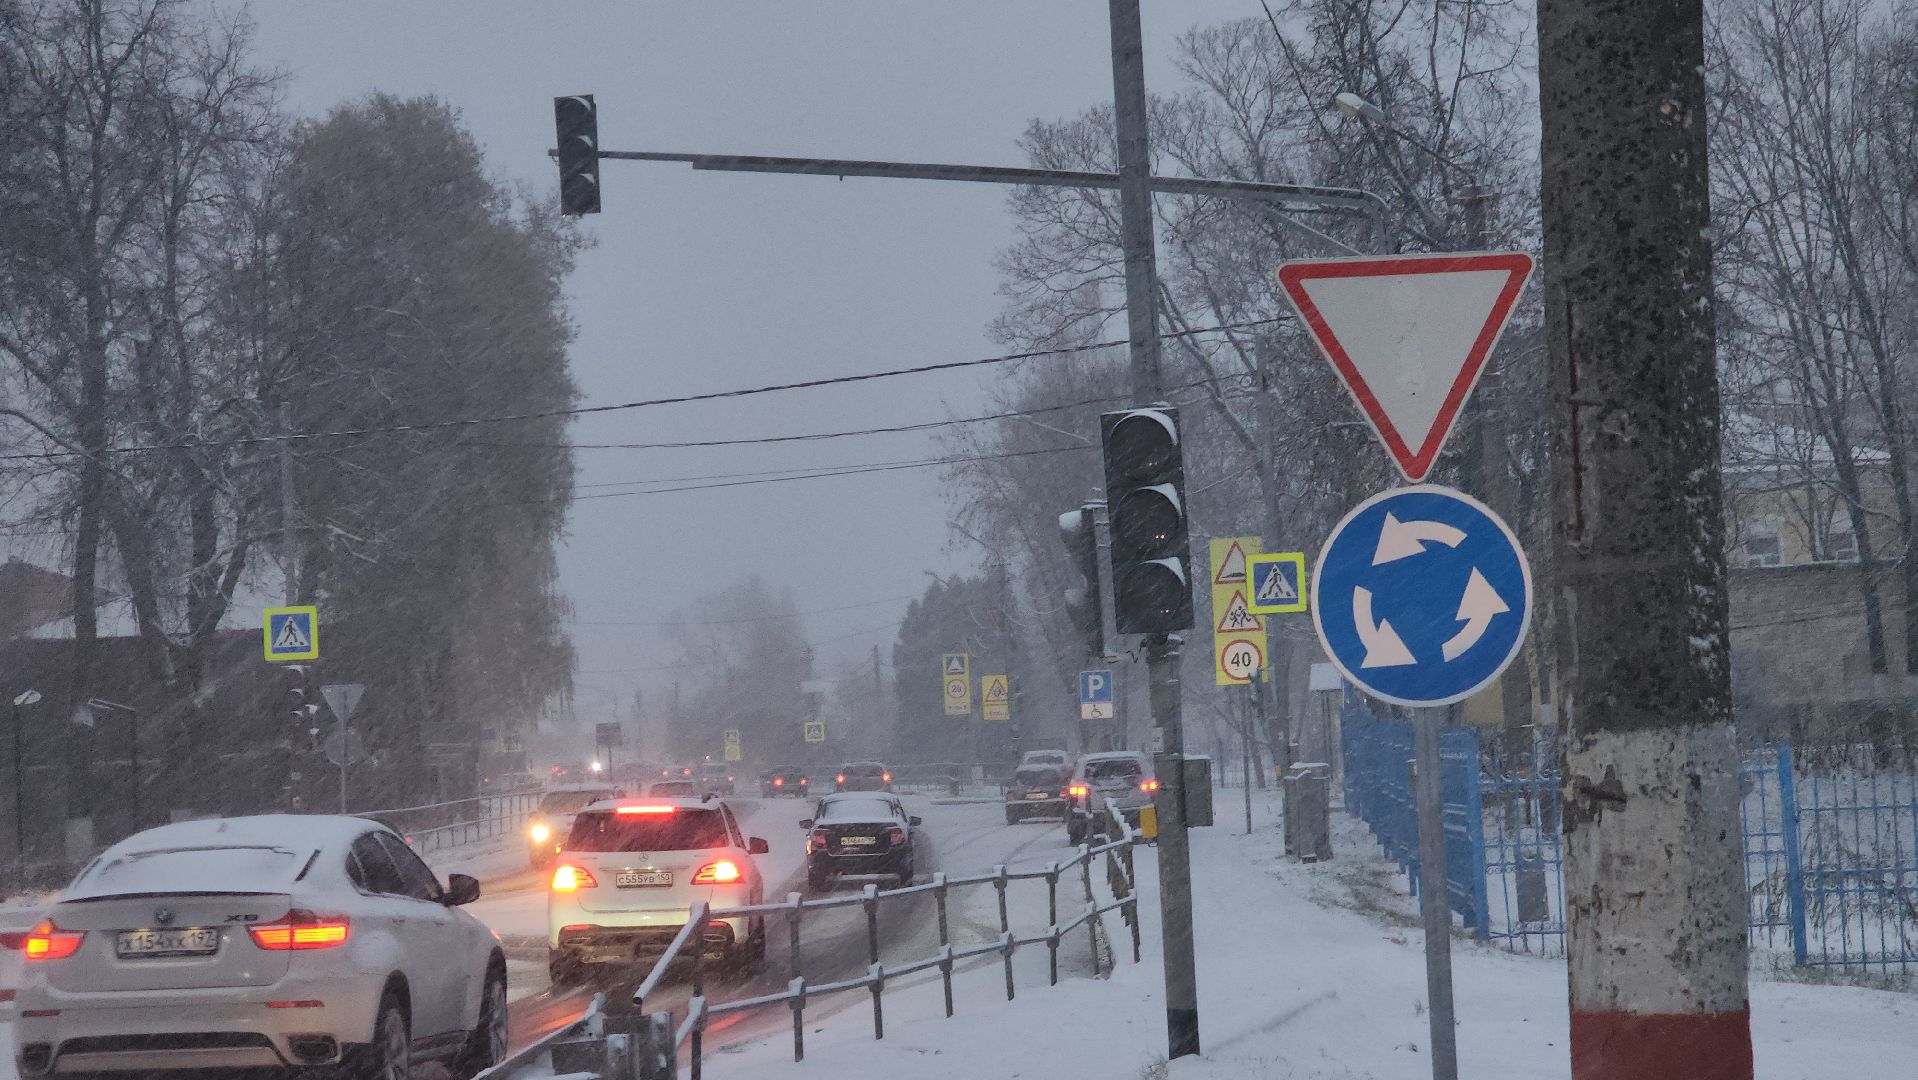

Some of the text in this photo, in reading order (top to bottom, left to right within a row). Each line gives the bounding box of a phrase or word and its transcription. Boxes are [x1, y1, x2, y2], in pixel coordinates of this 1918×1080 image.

[1230, 652, 1252, 667] 40
[1088, 674, 1104, 698] P
[224, 914, 259, 922] X6
